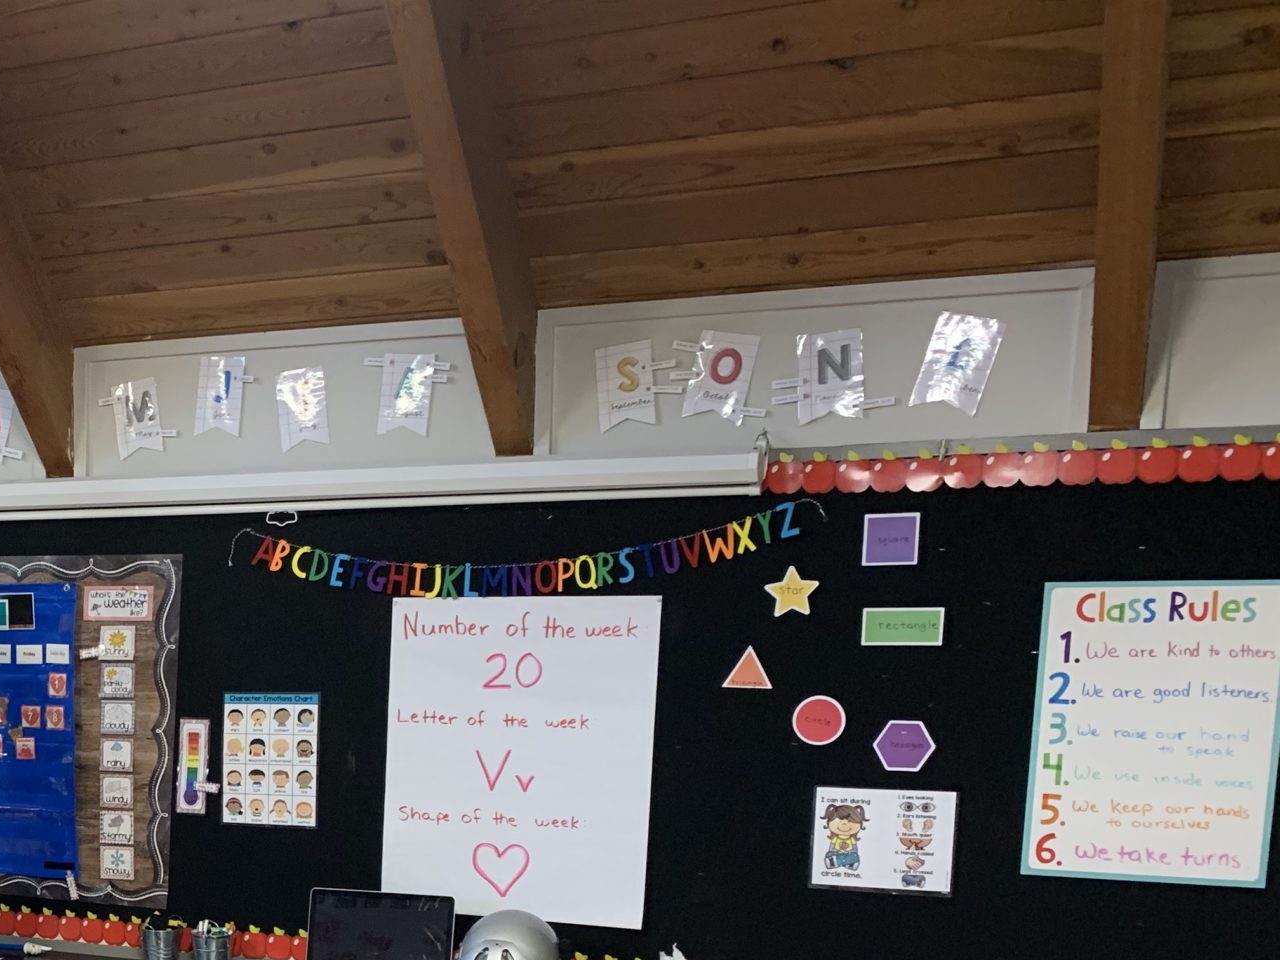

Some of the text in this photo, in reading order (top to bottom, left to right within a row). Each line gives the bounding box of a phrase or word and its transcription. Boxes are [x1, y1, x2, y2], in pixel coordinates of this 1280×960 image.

[616, 356, 640, 393] S
[710, 347, 743, 385] O
[817, 343, 851, 385] N
[103, 598, 147, 609] weather
[778, 585, 805, 595] star
[1075, 590, 1257, 623] Class Rules
[403, 611, 639, 640] Number of the week
[878, 620, 939, 633] rectangle
[1060, 630, 1080, 664] 1.
[1086, 641, 1120, 660] We
[1128, 647, 1158, 658] are
[1208, 645, 1221, 656] to
[482, 652, 543, 689] 20
[1048, 672, 1077, 705] 2.
[1081, 682, 1104, 698] We
[1112, 687, 1145, 699] are
[1153, 681, 1192, 704] good
[397, 708, 458, 724] Letter
[467, 710, 486, 727] of
[502, 712, 529, 728] the
[1048, 712, 1251, 746] 3. We raise our hand
[1158, 744, 1235, 759] to speak
[1042, 752, 1254, 790] 4. We use inside voices
[398, 805, 450, 825] Shape
[461, 808, 481, 824] of
[492, 811, 518, 827] the
[1040, 793, 1250, 827] 5. We keep our hands
[1106, 818, 1211, 831] to ourselves
[1035, 832, 1241, 870] 6. We take turns
